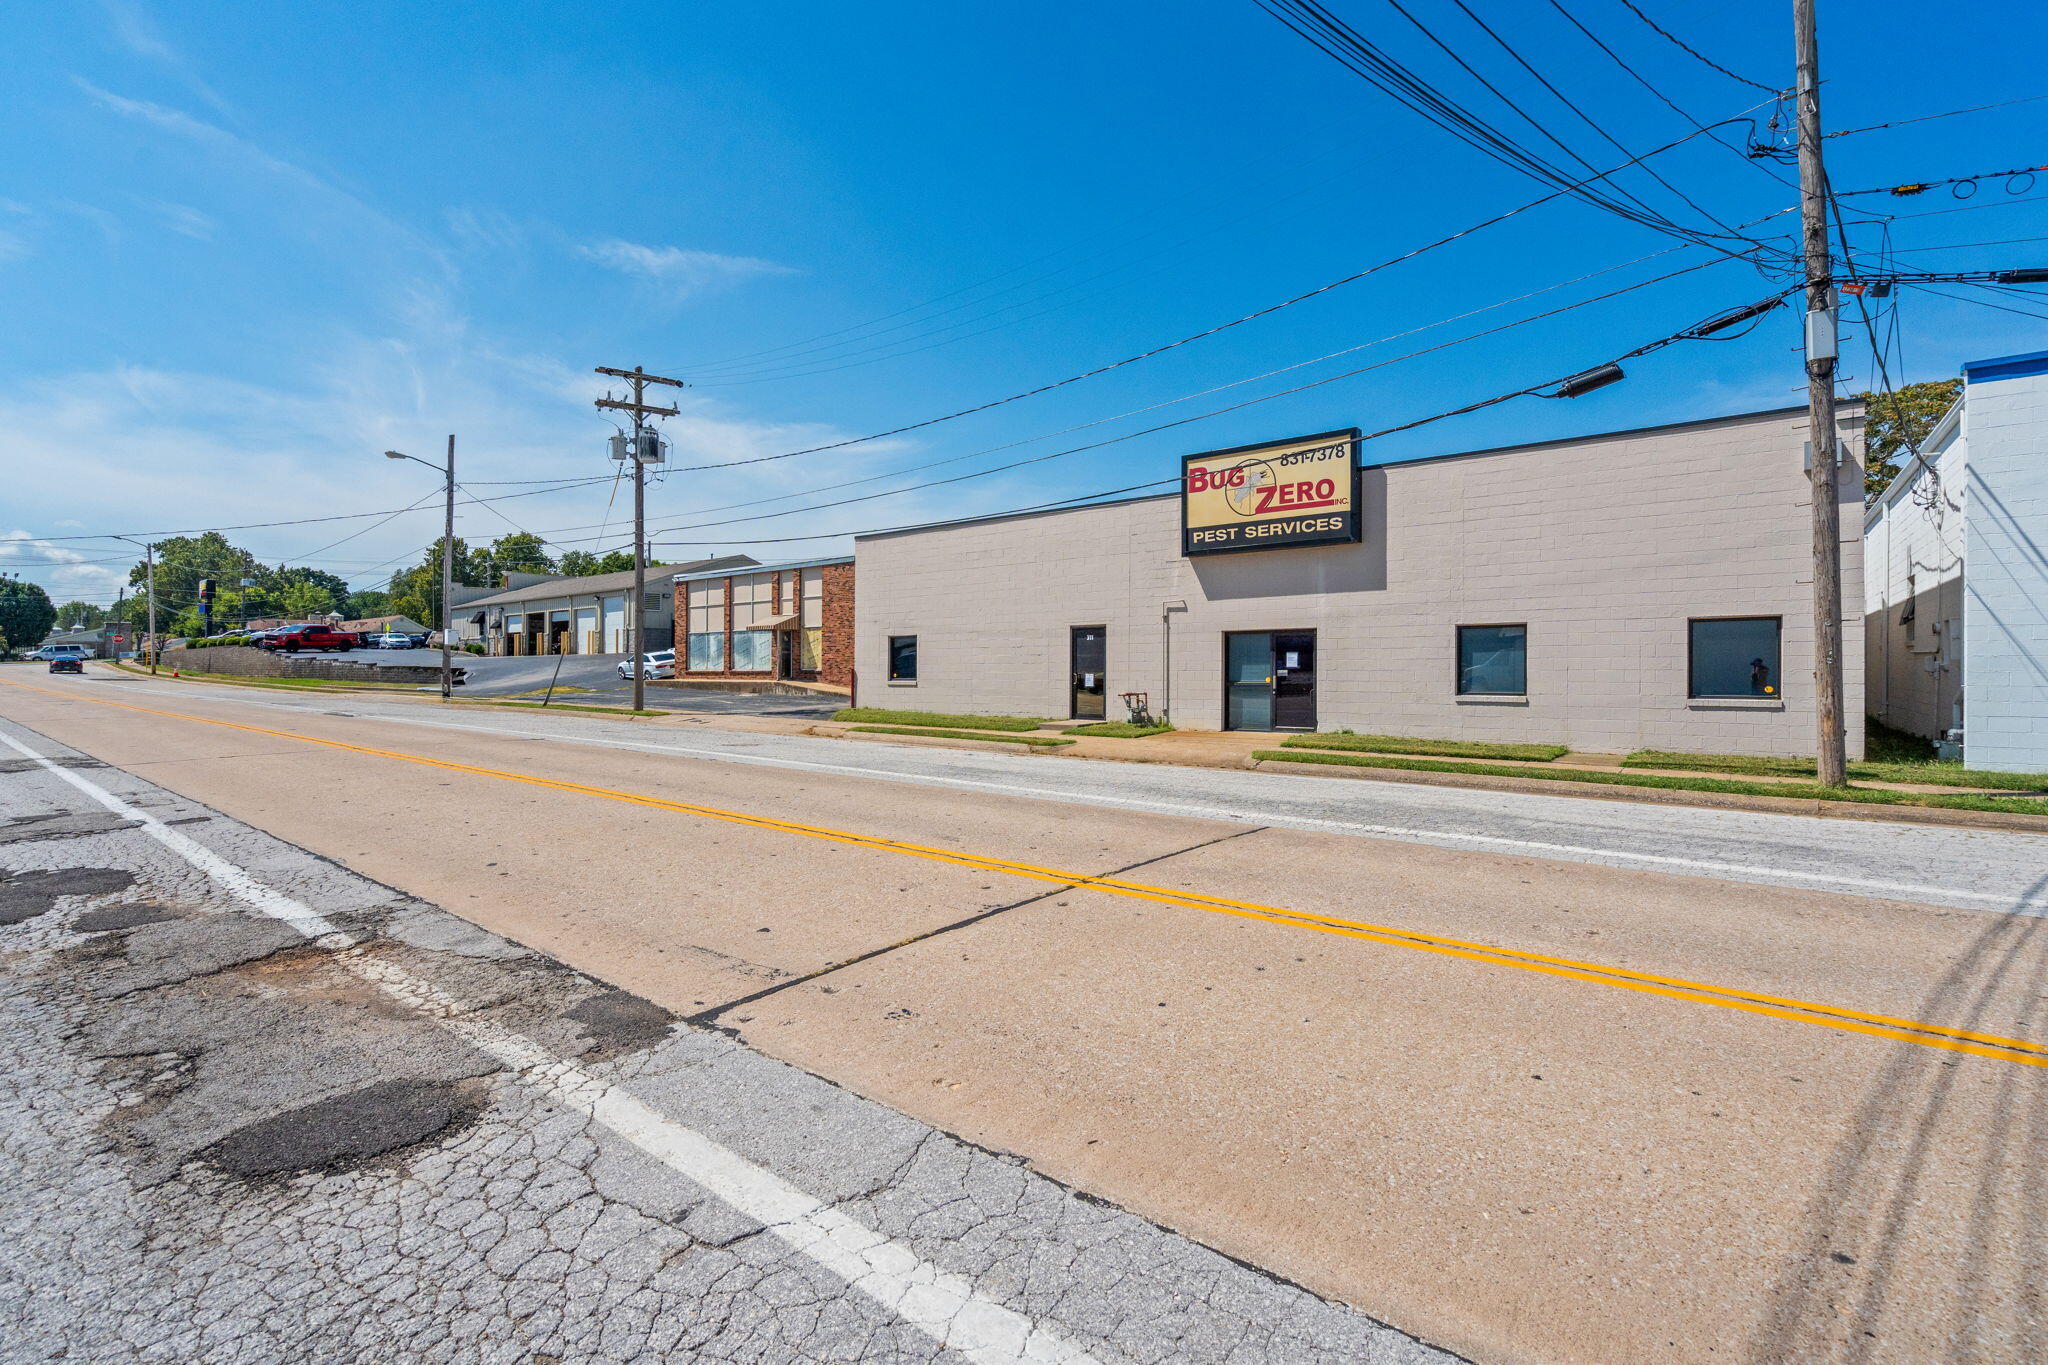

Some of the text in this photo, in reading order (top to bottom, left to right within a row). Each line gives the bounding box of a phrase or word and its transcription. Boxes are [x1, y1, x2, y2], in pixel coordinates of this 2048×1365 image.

[1281, 443, 1345, 466] 831-7378
[1188, 466, 1245, 493] BUG
[1255, 478, 1335, 514] ZERO
[1193, 517, 1343, 543] PEST SERVICES
